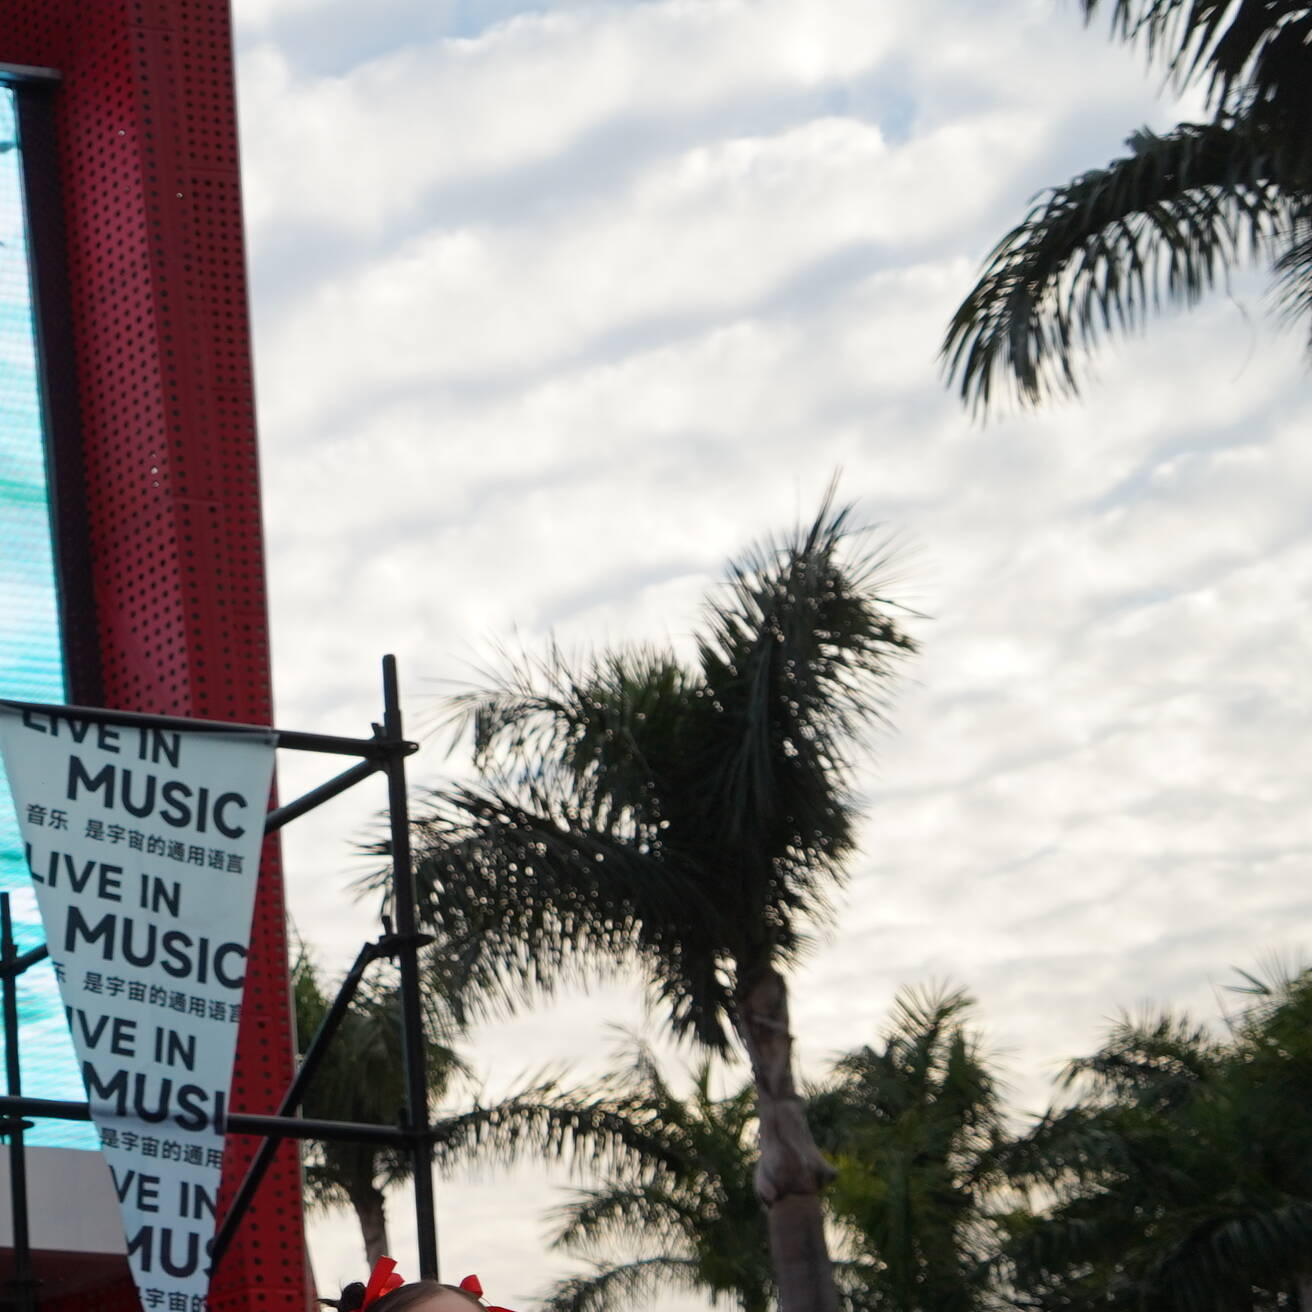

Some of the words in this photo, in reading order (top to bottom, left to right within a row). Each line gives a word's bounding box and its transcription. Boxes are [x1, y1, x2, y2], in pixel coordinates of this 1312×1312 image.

[23, 711, 121, 754] LIVE
[138, 727, 182, 769] IN
[66, 754, 249, 839] MUSIC
[26, 803, 69, 831] 音乐
[84, 818, 246, 875] 是宇宙的通用语言
[139, 873, 182, 918] IN
[64, 905, 249, 990] MUSIC
[154, 1026, 196, 1072] IN
